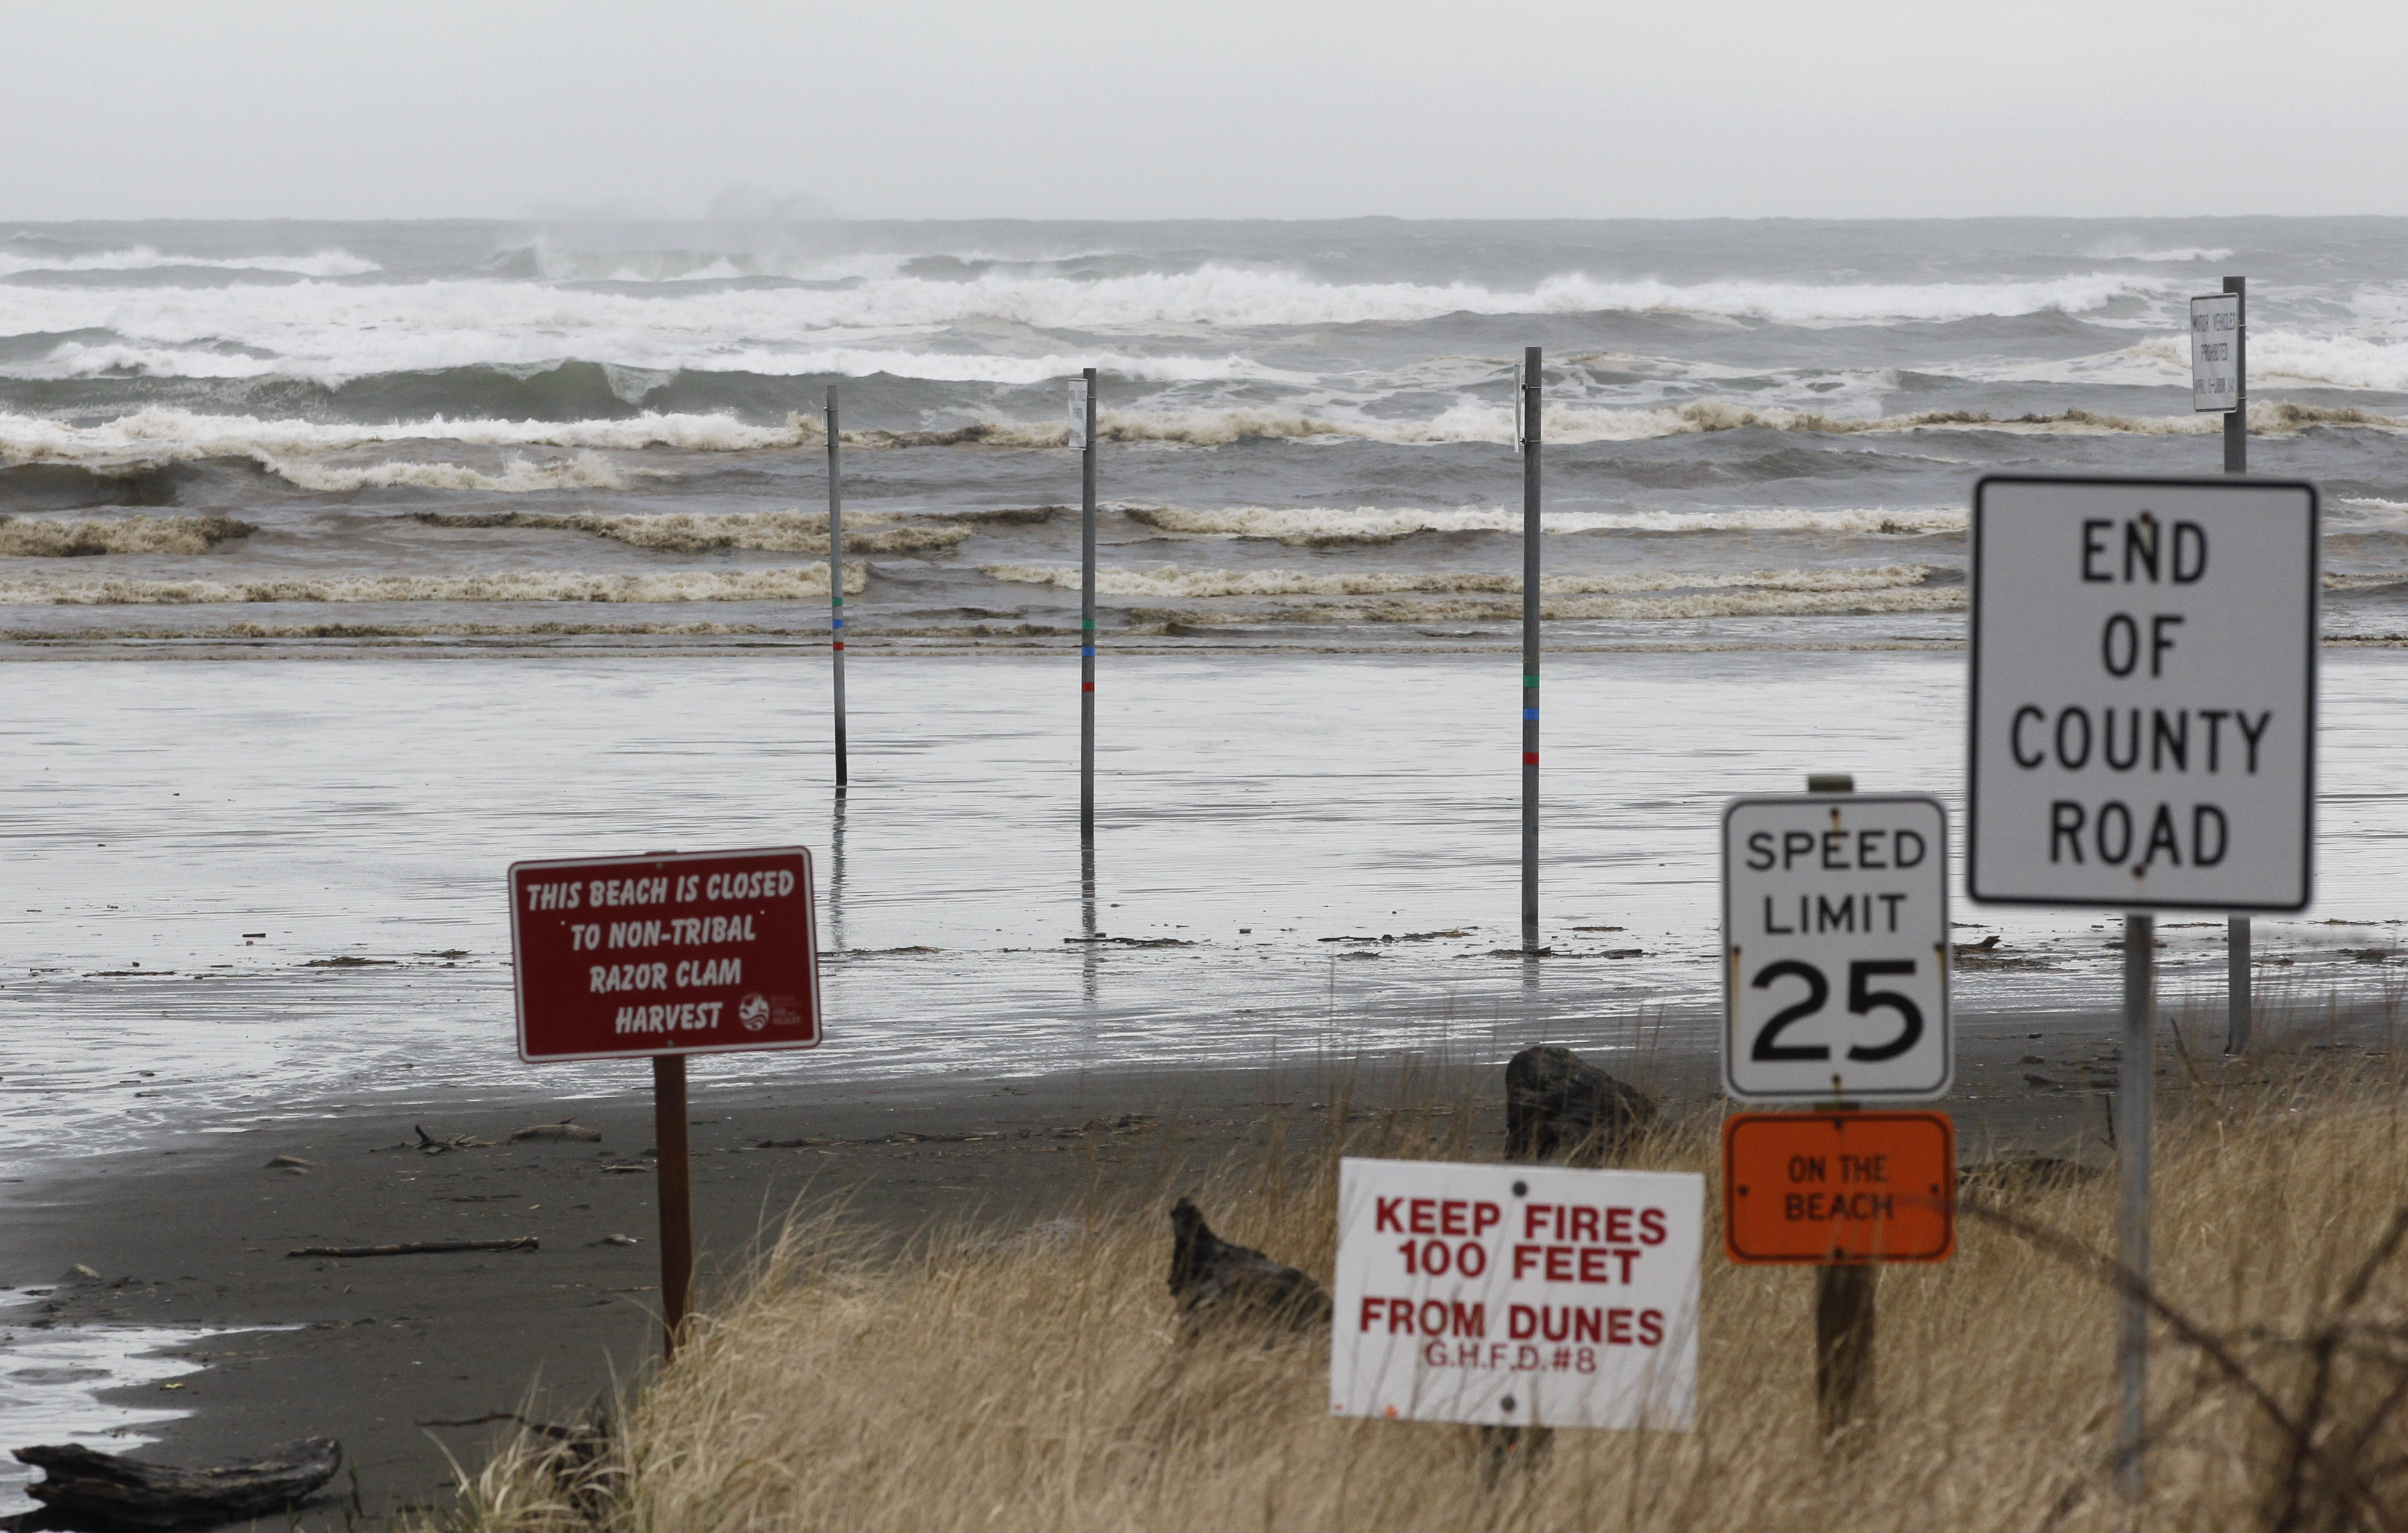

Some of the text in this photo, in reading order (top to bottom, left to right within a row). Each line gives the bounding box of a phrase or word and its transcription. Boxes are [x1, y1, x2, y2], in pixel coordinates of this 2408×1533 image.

[2082, 519, 2207, 583] END
[2102, 612, 2184, 678] OF
[2010, 705, 2273, 774] COUNTY
[1746, 830, 1926, 870] SPEED
[2049, 800, 2228, 868] ROAD
[526, 870, 795, 911] THIS BEACH IS CLOSED
[571, 914, 756, 951] TO NON-TRIBAL
[1764, 894, 1906, 935] LIMIT
[589, 958, 742, 993] RAZOR CLAM
[615, 1002, 723, 1034] HARVEST
[1750, 959, 1924, 1062] 25
[1787, 1153, 1889, 1183] ON THE
[1376, 1197, 1669, 1246] KEEP FIRES
[1785, 1192, 1894, 1222] BEACH
[1397, 1239, 1643, 1285] 100 FEET
[1359, 1297, 1665, 1348] FROM DUNES
